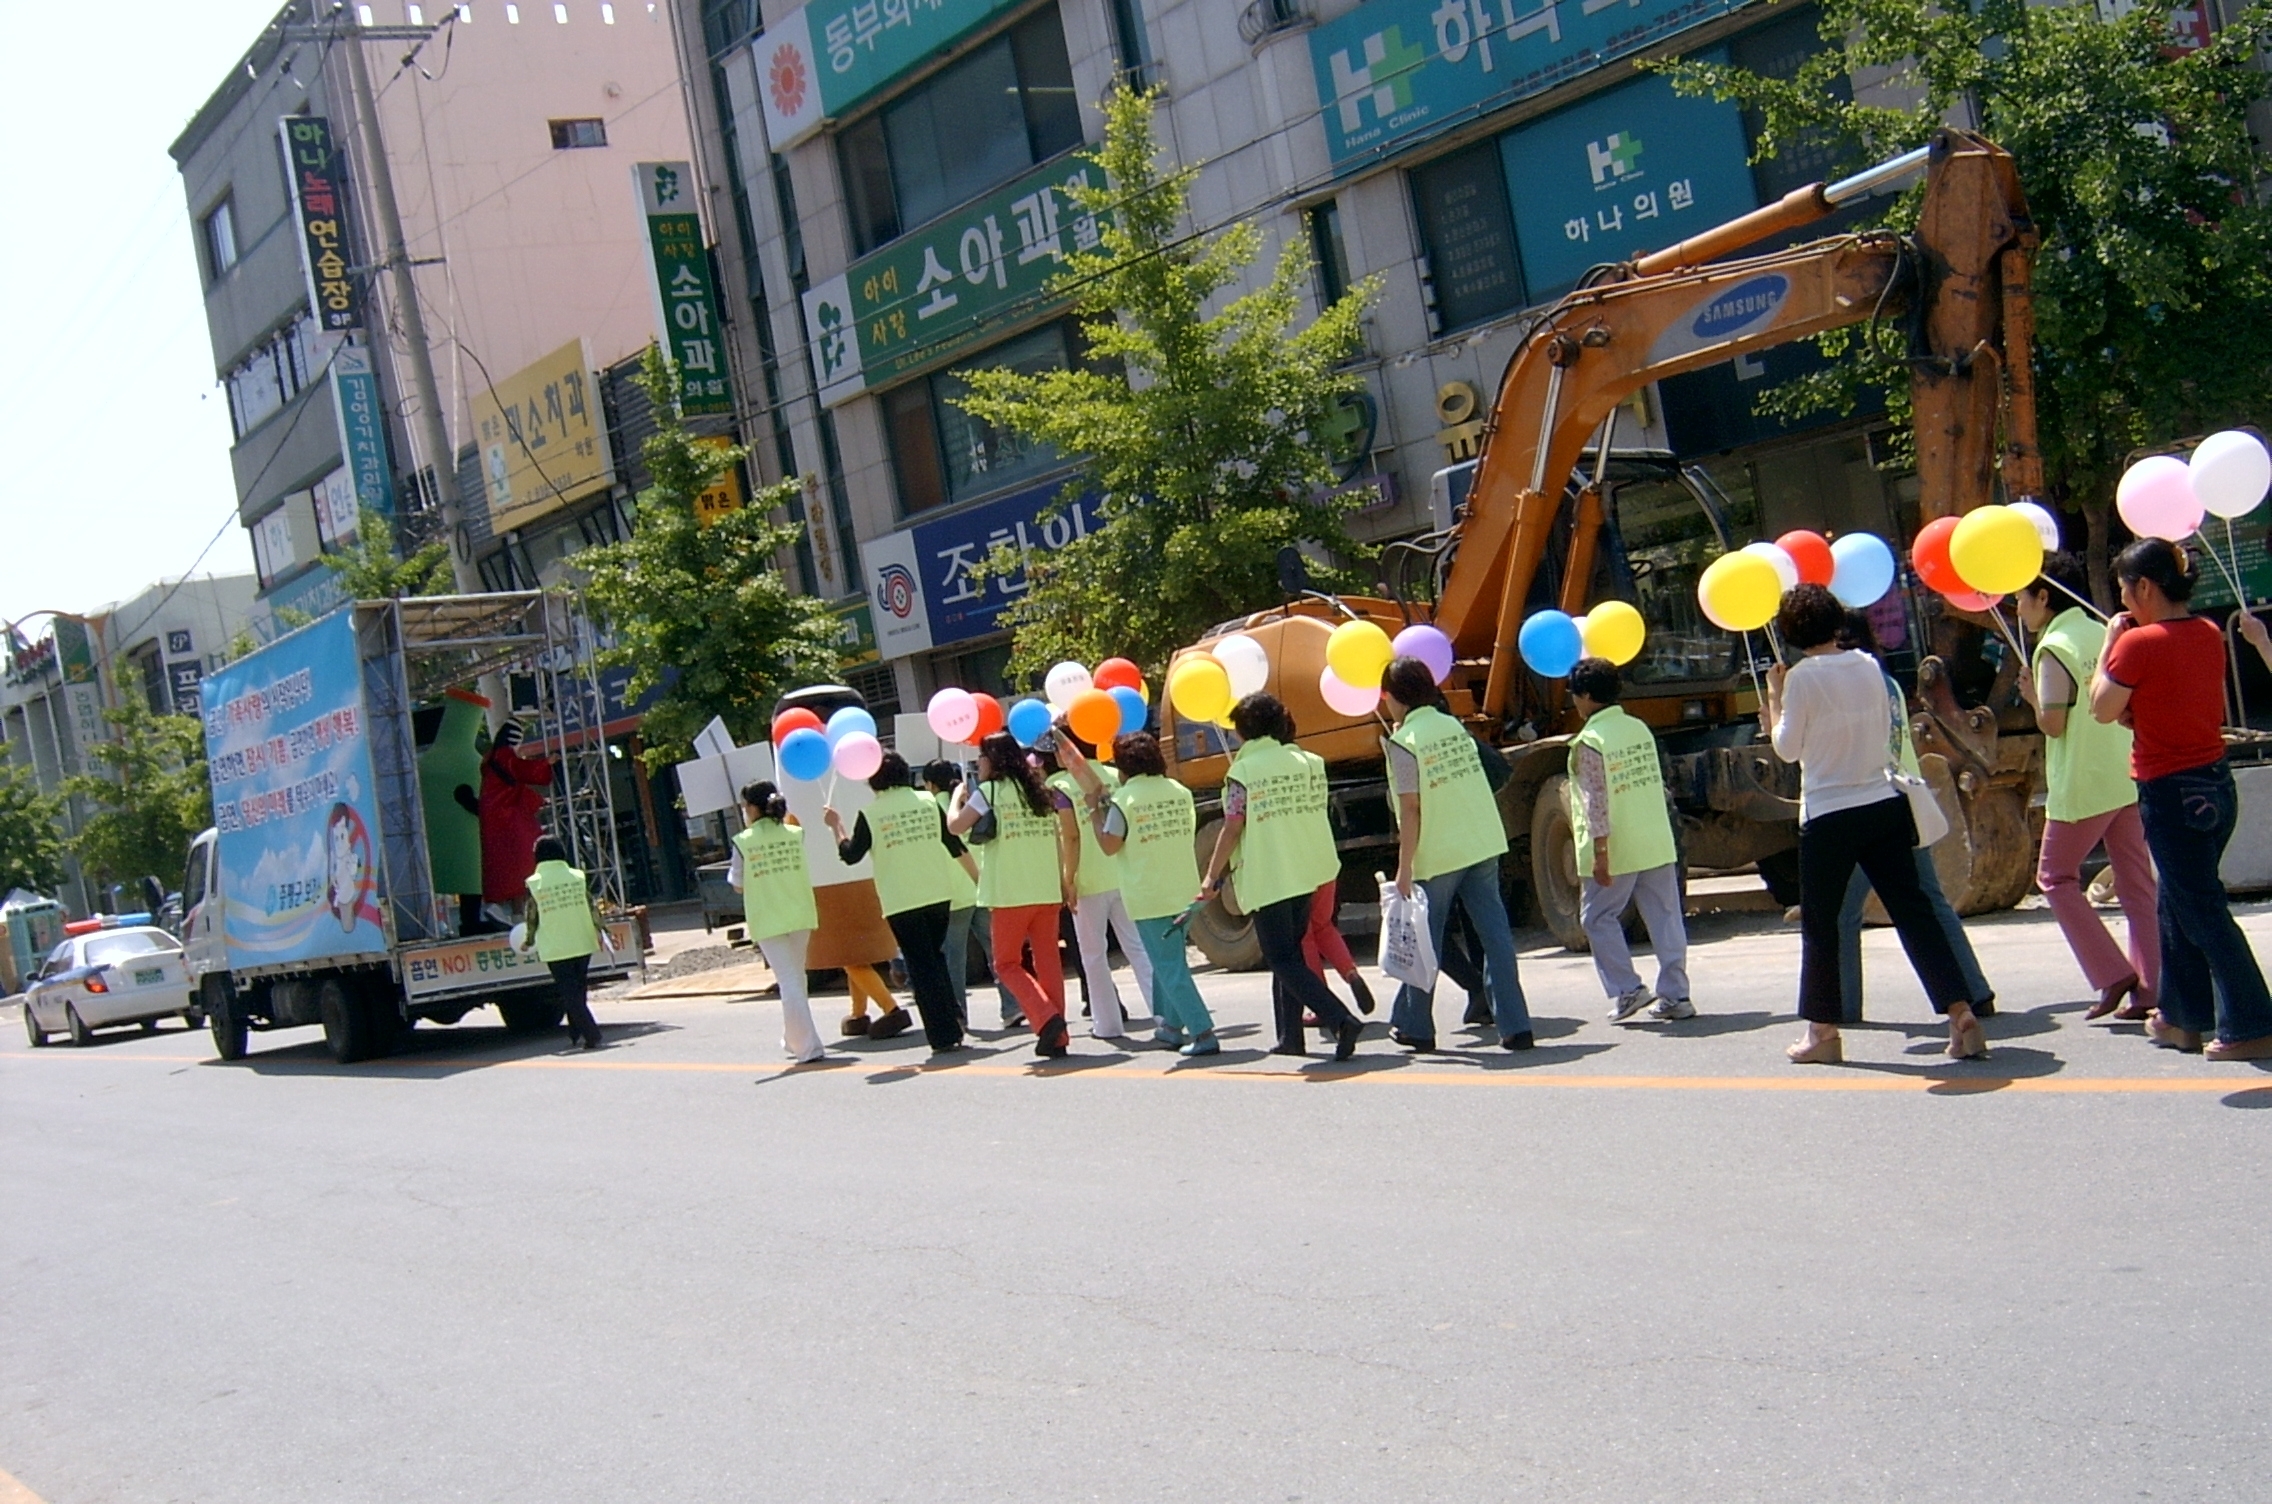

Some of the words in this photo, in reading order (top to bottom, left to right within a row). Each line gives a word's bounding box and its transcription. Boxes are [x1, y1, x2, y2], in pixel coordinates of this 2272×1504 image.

[1389, 105, 1430, 129] Clinic
[1564, 178, 1694, 242] 하나의원
[916, 185, 1063, 320] 소아과
[1703, 291, 1778, 323] SAMSUNG
[410, 957, 438, 982] 흡연
[442, 954, 472, 976] NO!
